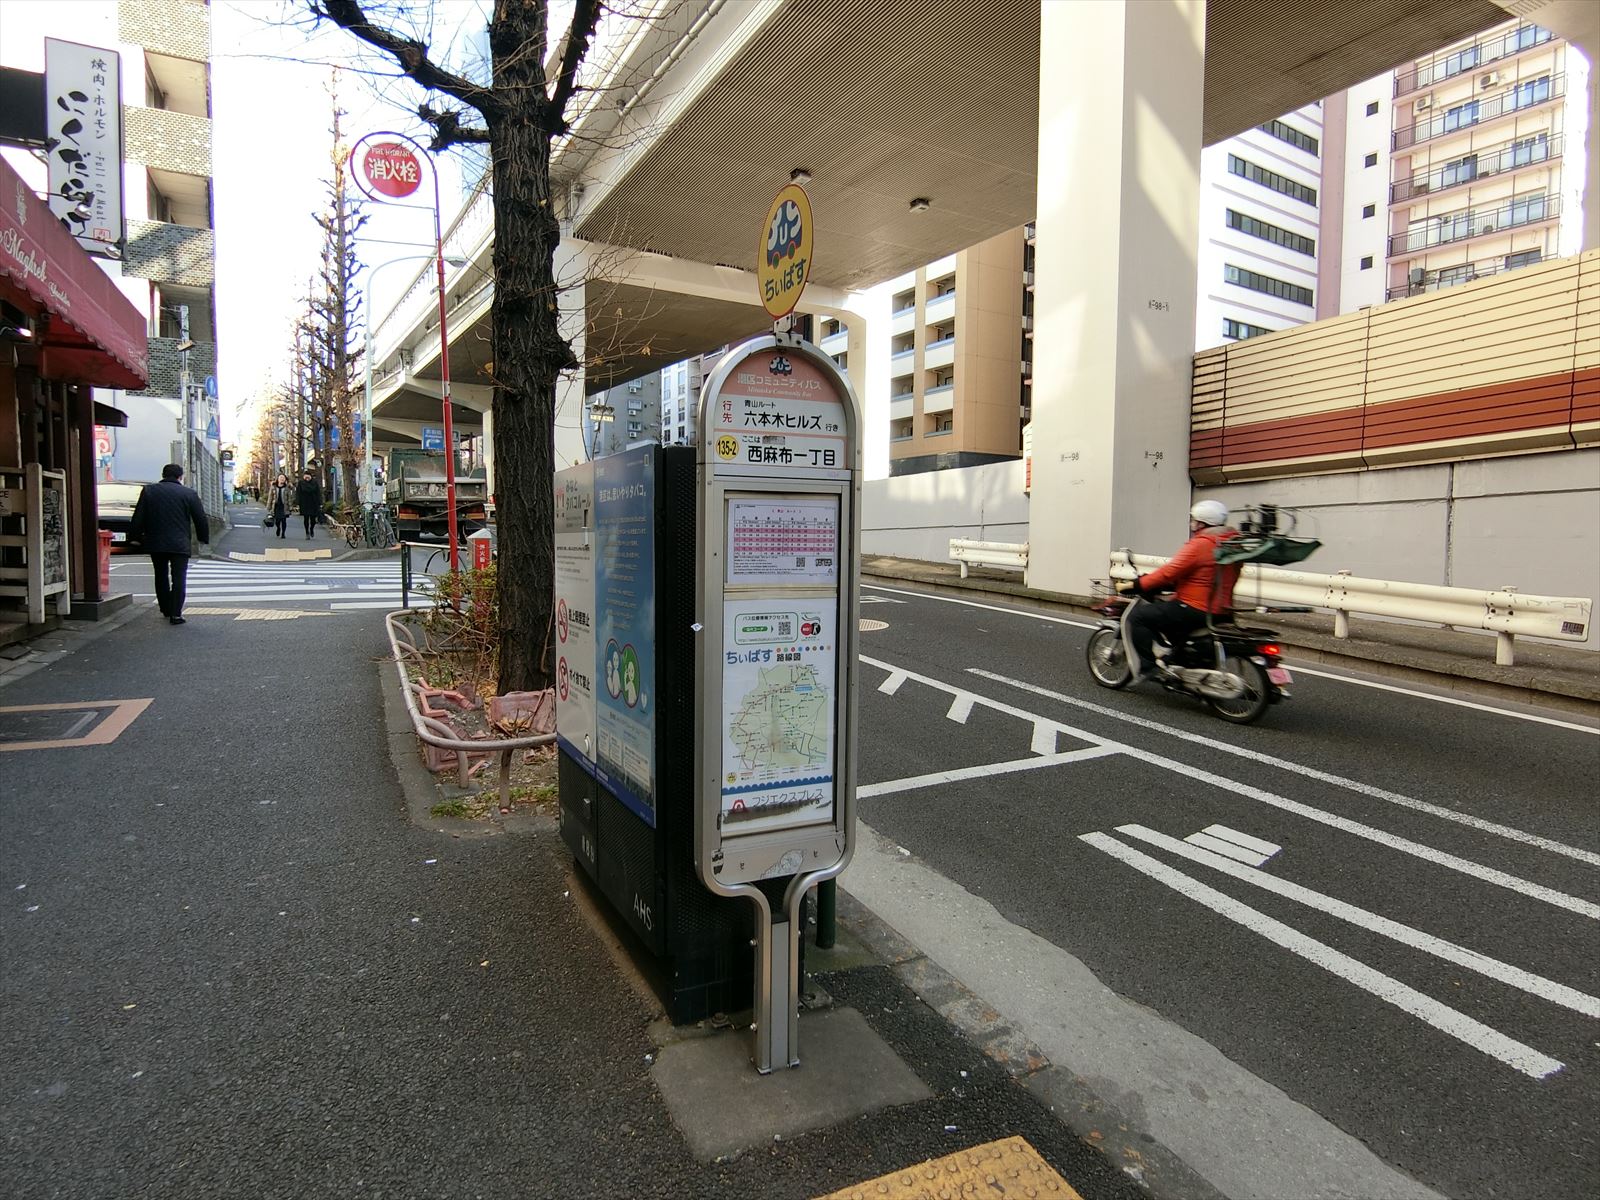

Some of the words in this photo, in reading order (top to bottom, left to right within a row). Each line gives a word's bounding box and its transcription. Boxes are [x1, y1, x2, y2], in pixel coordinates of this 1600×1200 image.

[91, 58, 108, 140] 焼肉・ホルモン
[371, 147, 384, 156] FIRE
[368, 157, 418, 183] 消火栓
[744, 399, 776, 409] 青山ルート
[744, 411, 822, 431] 六本木ヒルズ
[741, 435, 761, 444] ここは
[717, 440, 737, 456] 135-2
[748, 445, 835, 466] 西麻布一丁目
[776, 652, 801, 662] 路線図
